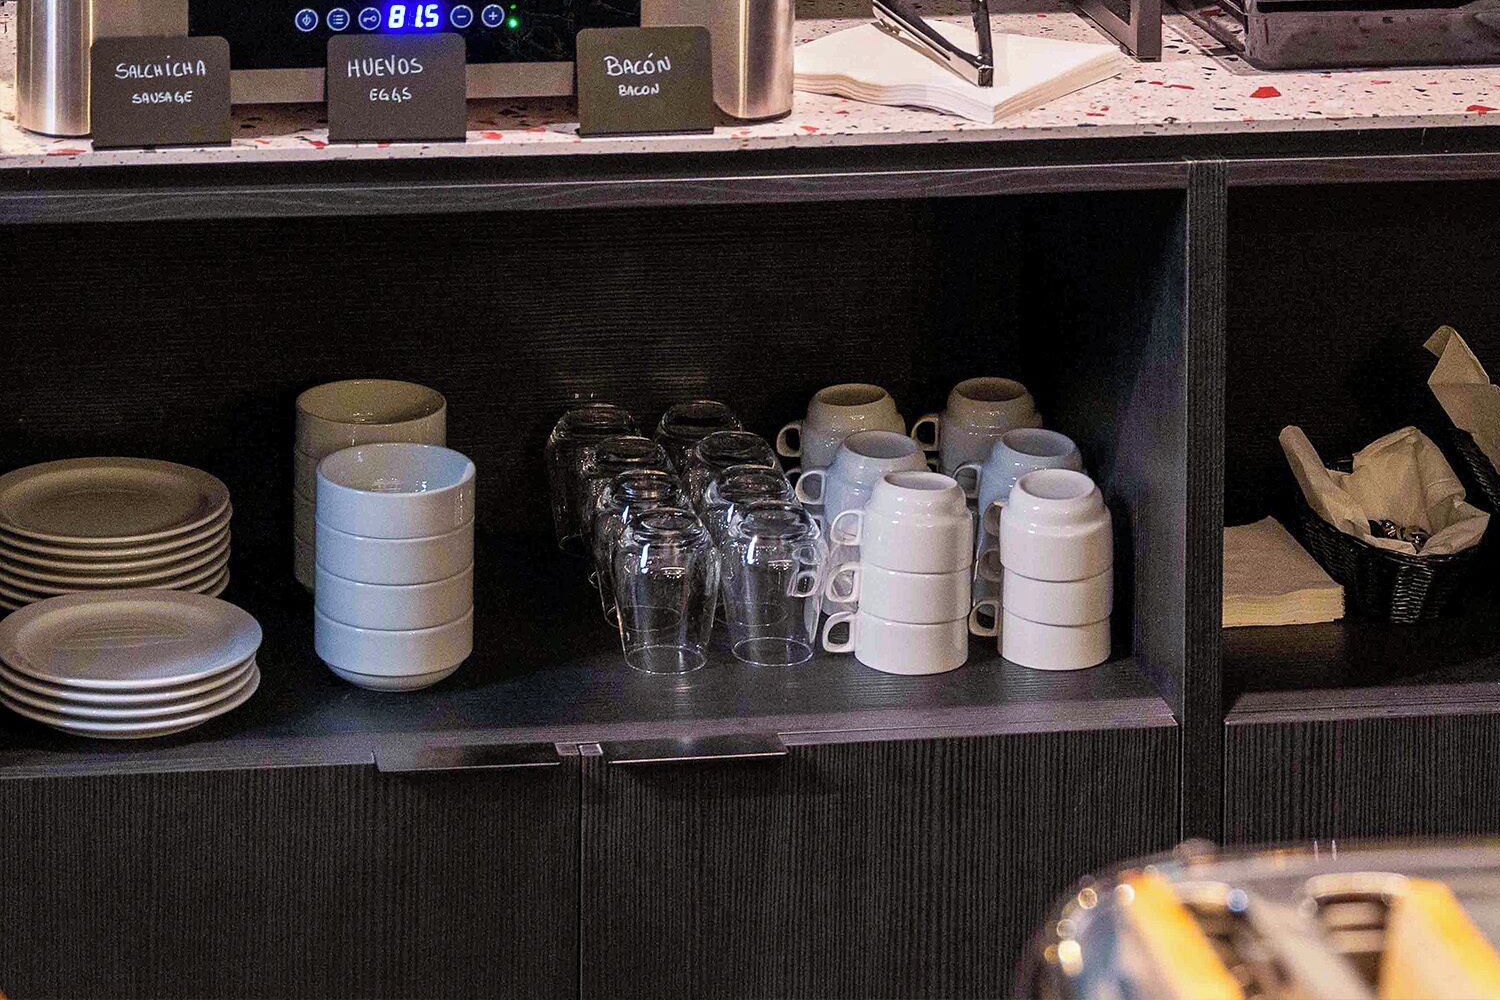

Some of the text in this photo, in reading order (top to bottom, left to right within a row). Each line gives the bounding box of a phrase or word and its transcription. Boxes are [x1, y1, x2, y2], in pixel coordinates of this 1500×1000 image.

[347, 54, 423, 78] HUEVOS
[603, 53, 671, 76] BACÓN
[131, 90, 193, 104] SAUSAGE
[369, 87, 412, 103] EGGS
[618, 83, 660, 97] BACON
